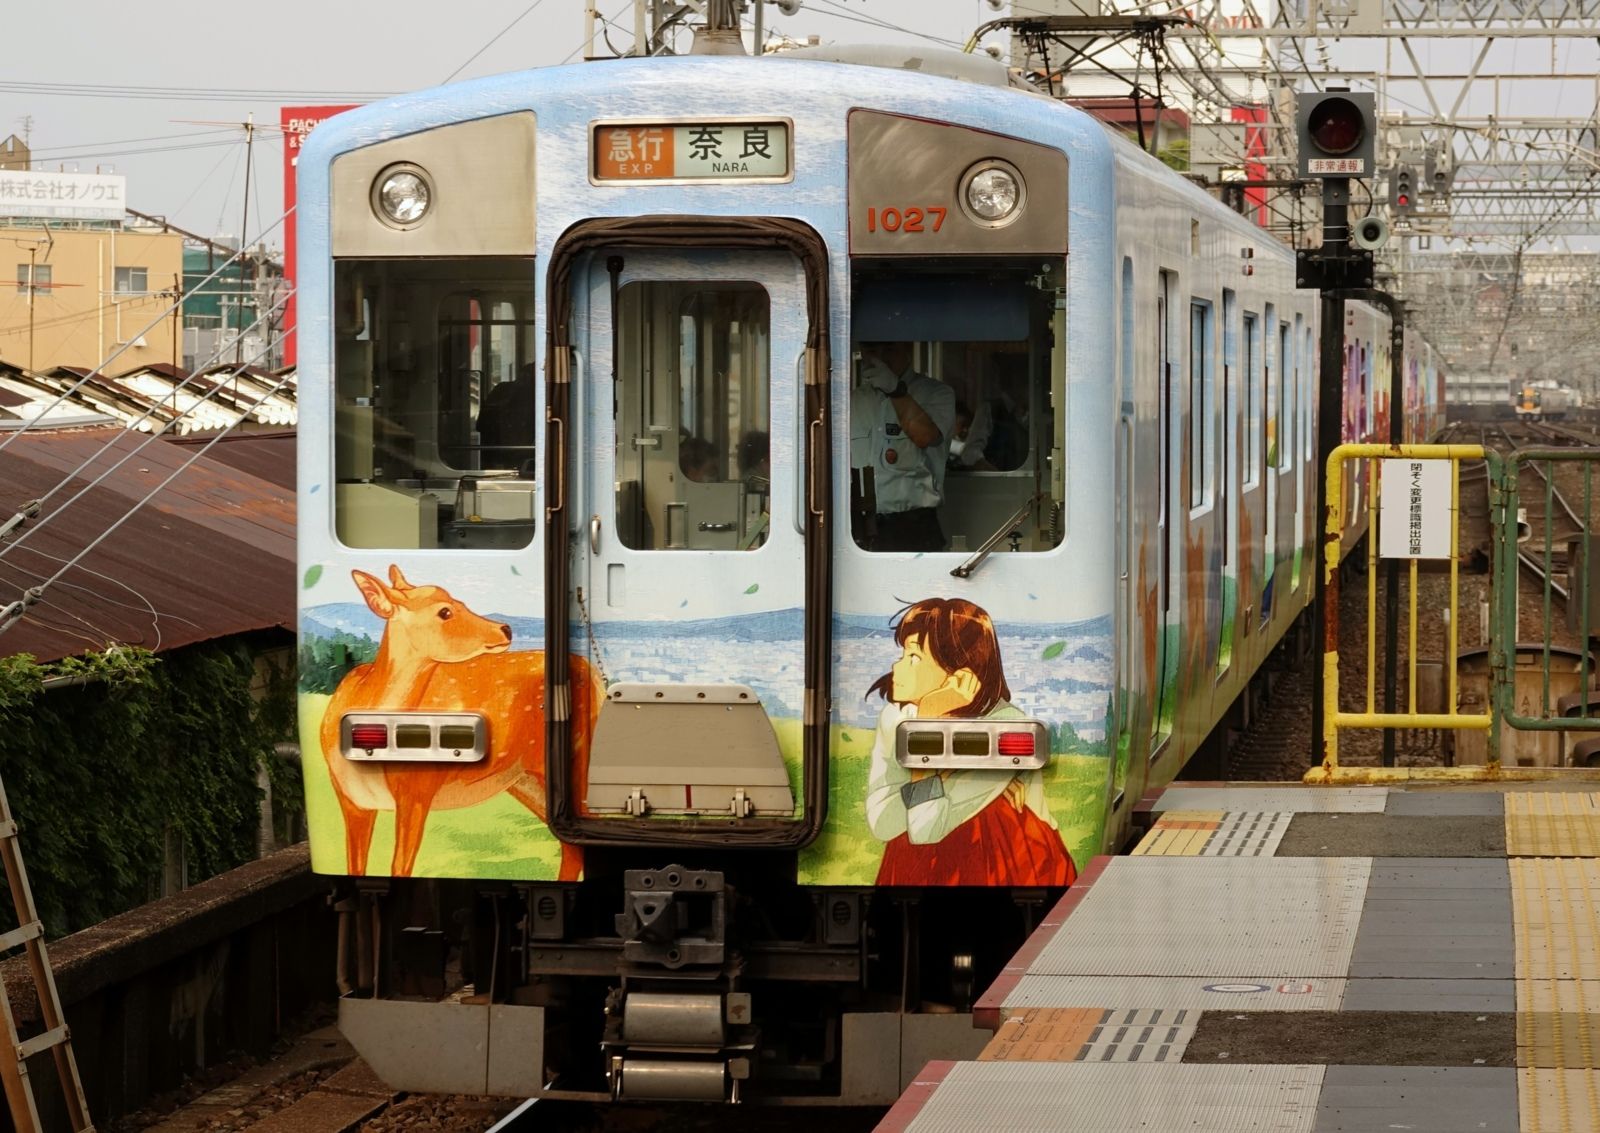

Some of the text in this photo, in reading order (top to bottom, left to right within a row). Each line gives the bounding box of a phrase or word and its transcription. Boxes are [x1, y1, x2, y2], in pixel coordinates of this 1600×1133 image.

[608, 129, 665, 162] 急行
[689, 127, 772, 160] 奈良
[712, 163, 749, 173] NARA
[1314, 160, 1358, 171] 非常通報
[868, 207, 947, 232] 1027
